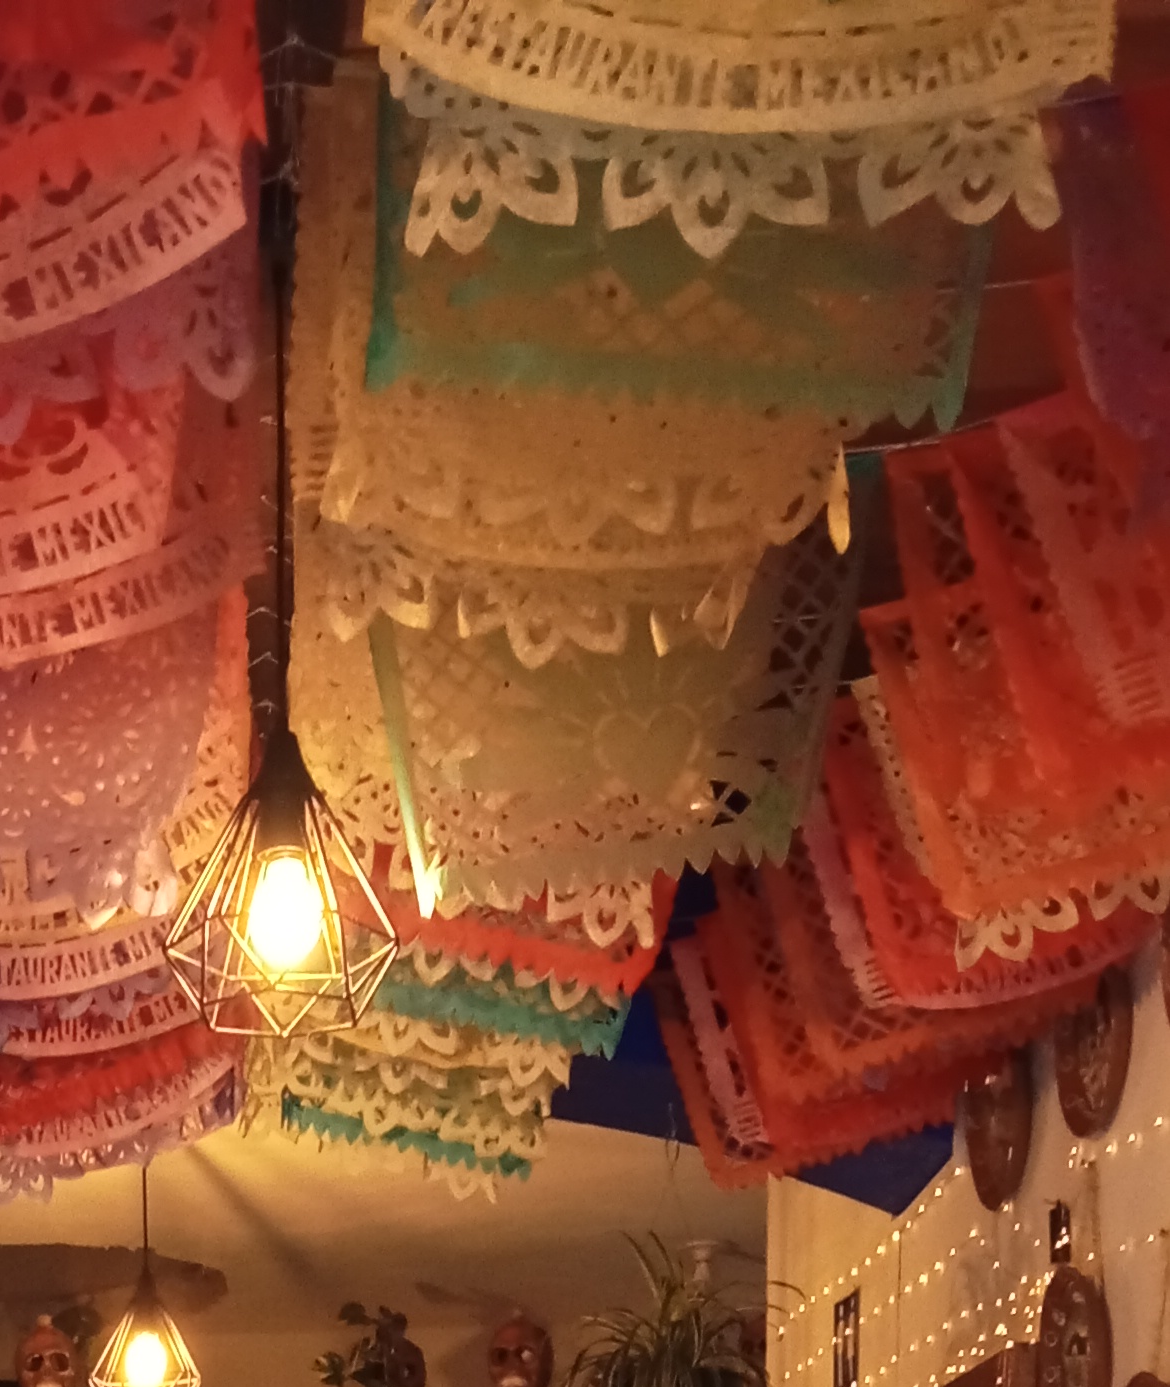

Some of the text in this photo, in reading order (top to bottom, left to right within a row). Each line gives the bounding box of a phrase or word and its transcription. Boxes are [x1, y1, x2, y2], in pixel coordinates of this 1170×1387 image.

[756, 18, 1016, 108] MEXICANO
[24, 152, 236, 310] MEXICANO
[69, 534, 230, 634] MEXICANO
